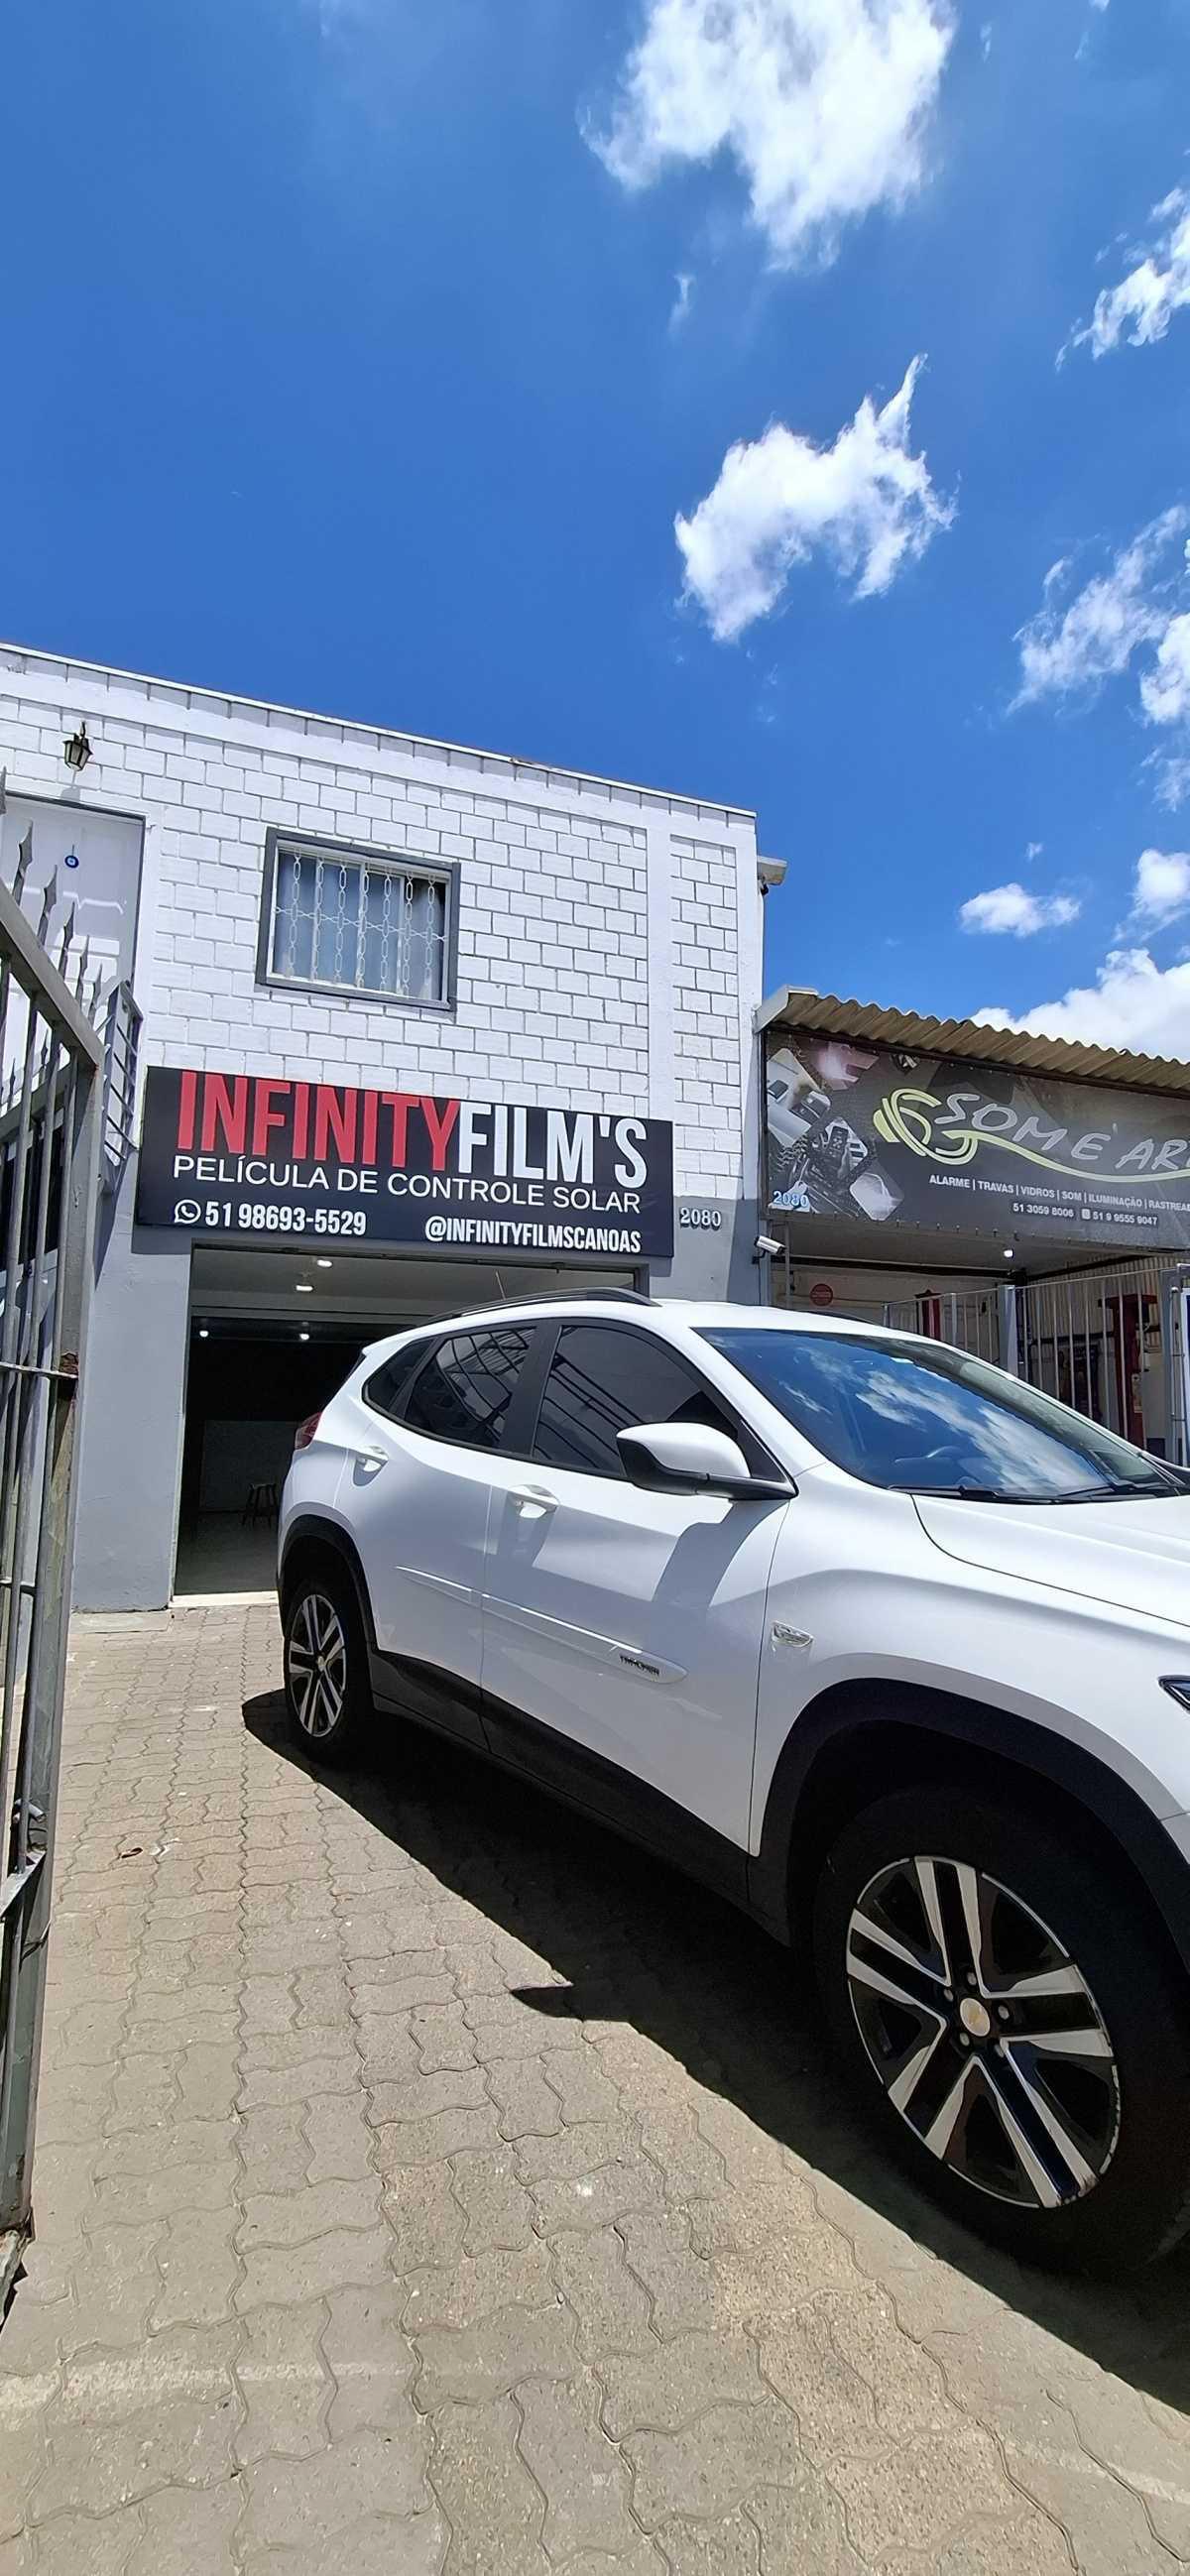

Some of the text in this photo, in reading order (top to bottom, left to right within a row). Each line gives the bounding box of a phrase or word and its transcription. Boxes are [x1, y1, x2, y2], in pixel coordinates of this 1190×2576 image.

[178, 1071, 647, 1189] INFINITYFILM'S
[934, 1093, 1068, 1151] SOM
[1115, 1138, 1190, 1170] AR
[174, 1155, 641, 1215] PELÍCULA DE CONTROLE SOLAR
[773, 1190, 810, 1208] 2080
[929, 1174, 971, 1189] ALARME
[978, 1180, 1013, 1194] TRAVAS
[1020, 1186, 1055, 1199] VIDROS
[1062, 1190, 1082, 1202] SOM
[1089, 1193, 1142, 1209] ILUMINAÇÃO
[205, 1201, 367, 1236] 51 98693-5529
[680, 1207, 722, 1229] 2080
[1012, 1202, 1025, 1213] 51
[1026, 1204, 1049, 1215] 3059
[1093, 1211, 1104, 1221] 51
[424, 1215, 642, 1253] @INFINITYFILMSCANOAS
